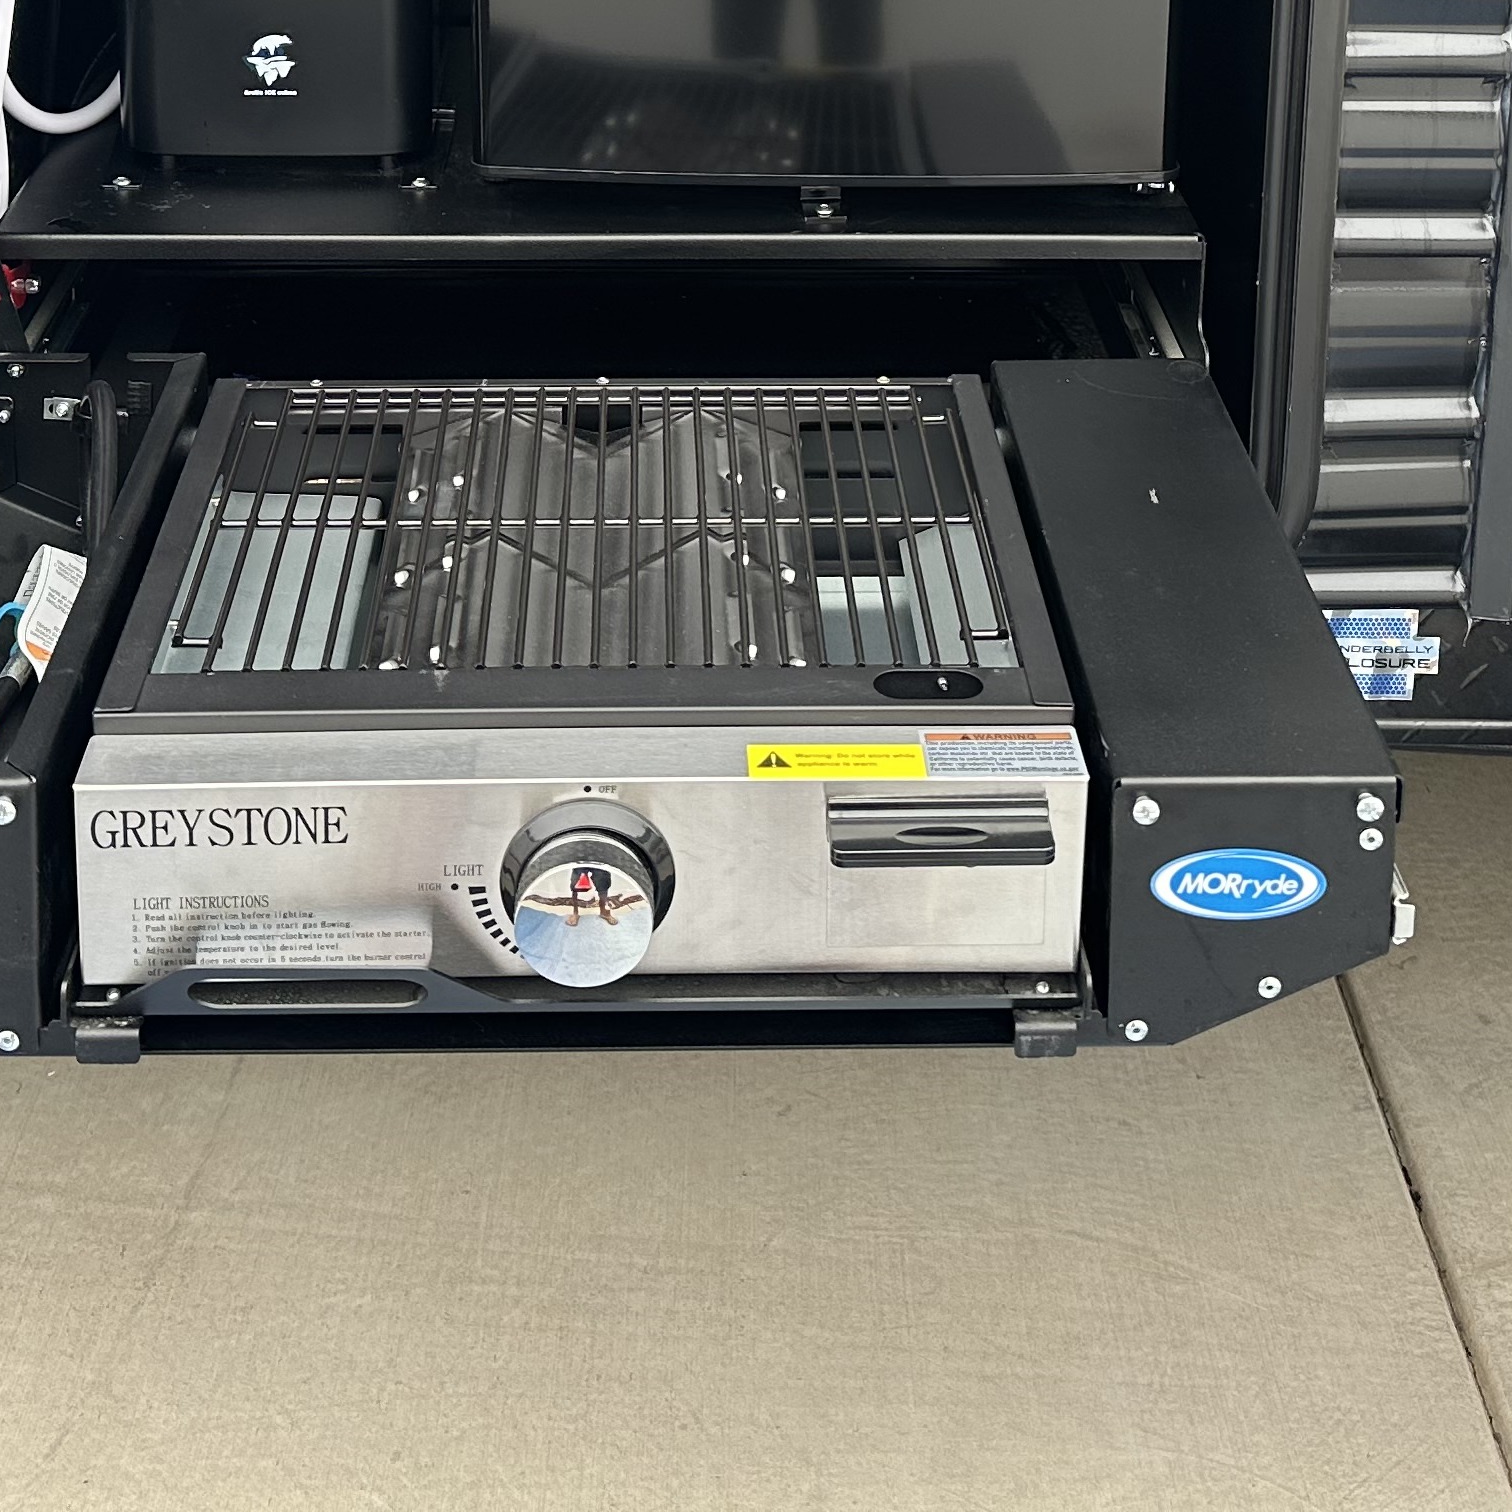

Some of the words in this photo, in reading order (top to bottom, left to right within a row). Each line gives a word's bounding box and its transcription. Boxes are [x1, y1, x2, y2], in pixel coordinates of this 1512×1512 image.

[1339, 645, 1434, 654] NDERBELLY
[1346, 657, 1431, 668] LOSURE
[599, 785, 617, 793] OFF
[90, 806, 349, 849] GREYSTONE
[444, 864, 484, 876] LIGHT
[418, 882, 442, 892] HIGH
[1177, 872, 1299, 899] MORryde
[133, 897, 171, 909] LIGHT
[179, 895, 269, 909] INSTRUCTIONS
